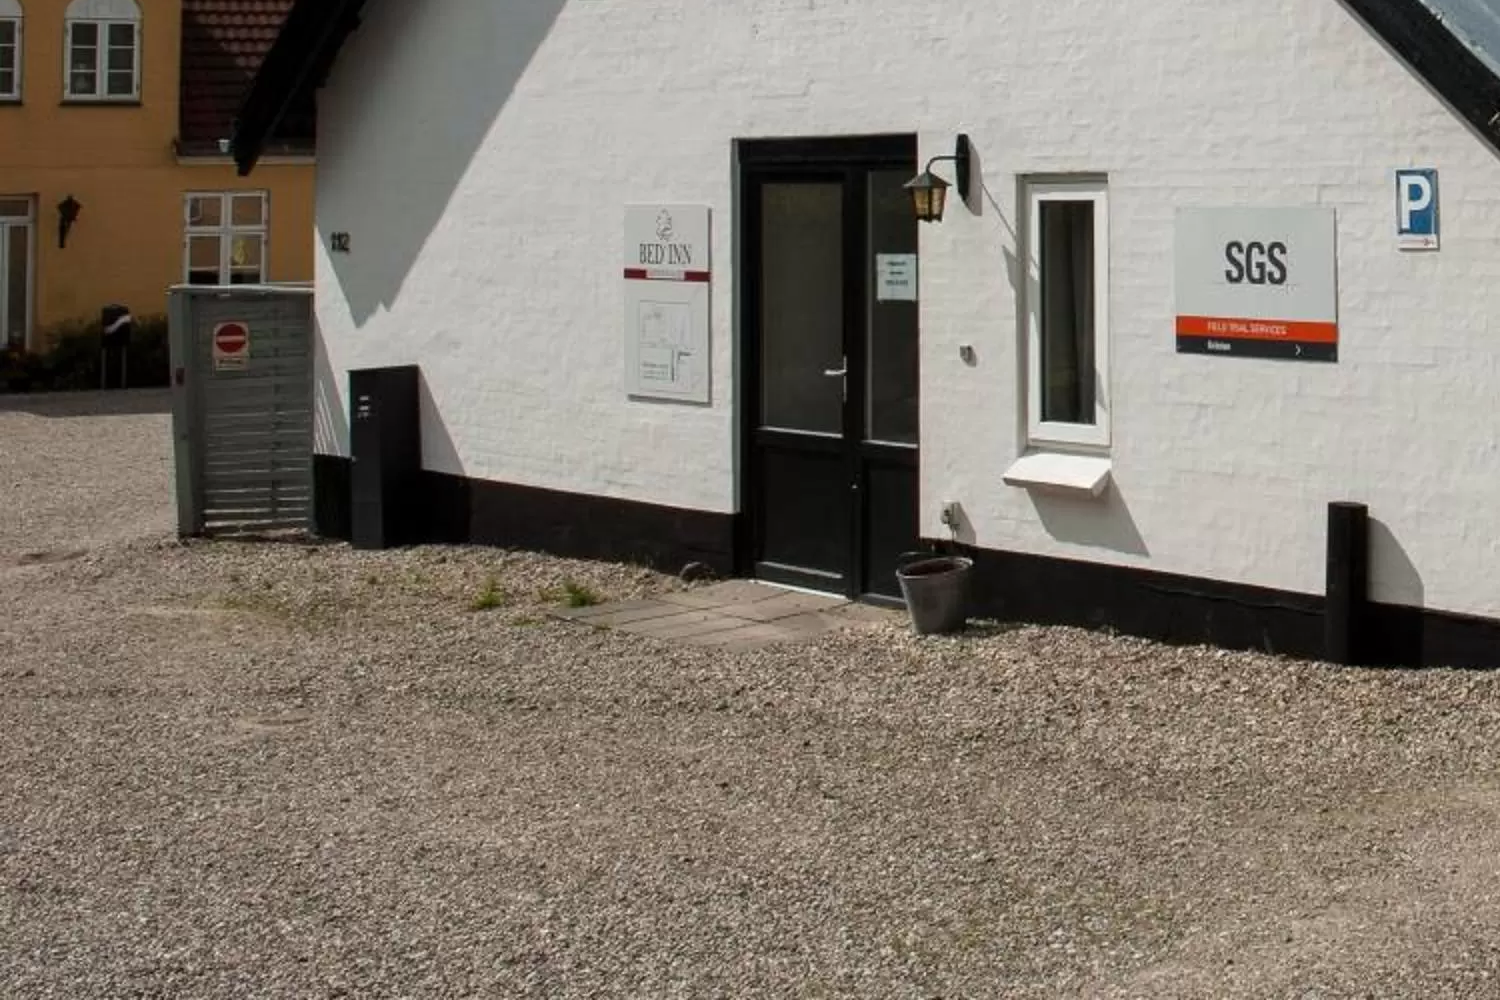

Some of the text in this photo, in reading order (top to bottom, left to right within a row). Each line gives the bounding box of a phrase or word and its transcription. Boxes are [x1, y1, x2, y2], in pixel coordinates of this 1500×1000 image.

[1399, 175, 1432, 230] P
[639, 243, 692, 265] BED INN
[1225, 241, 1287, 285] SGS
